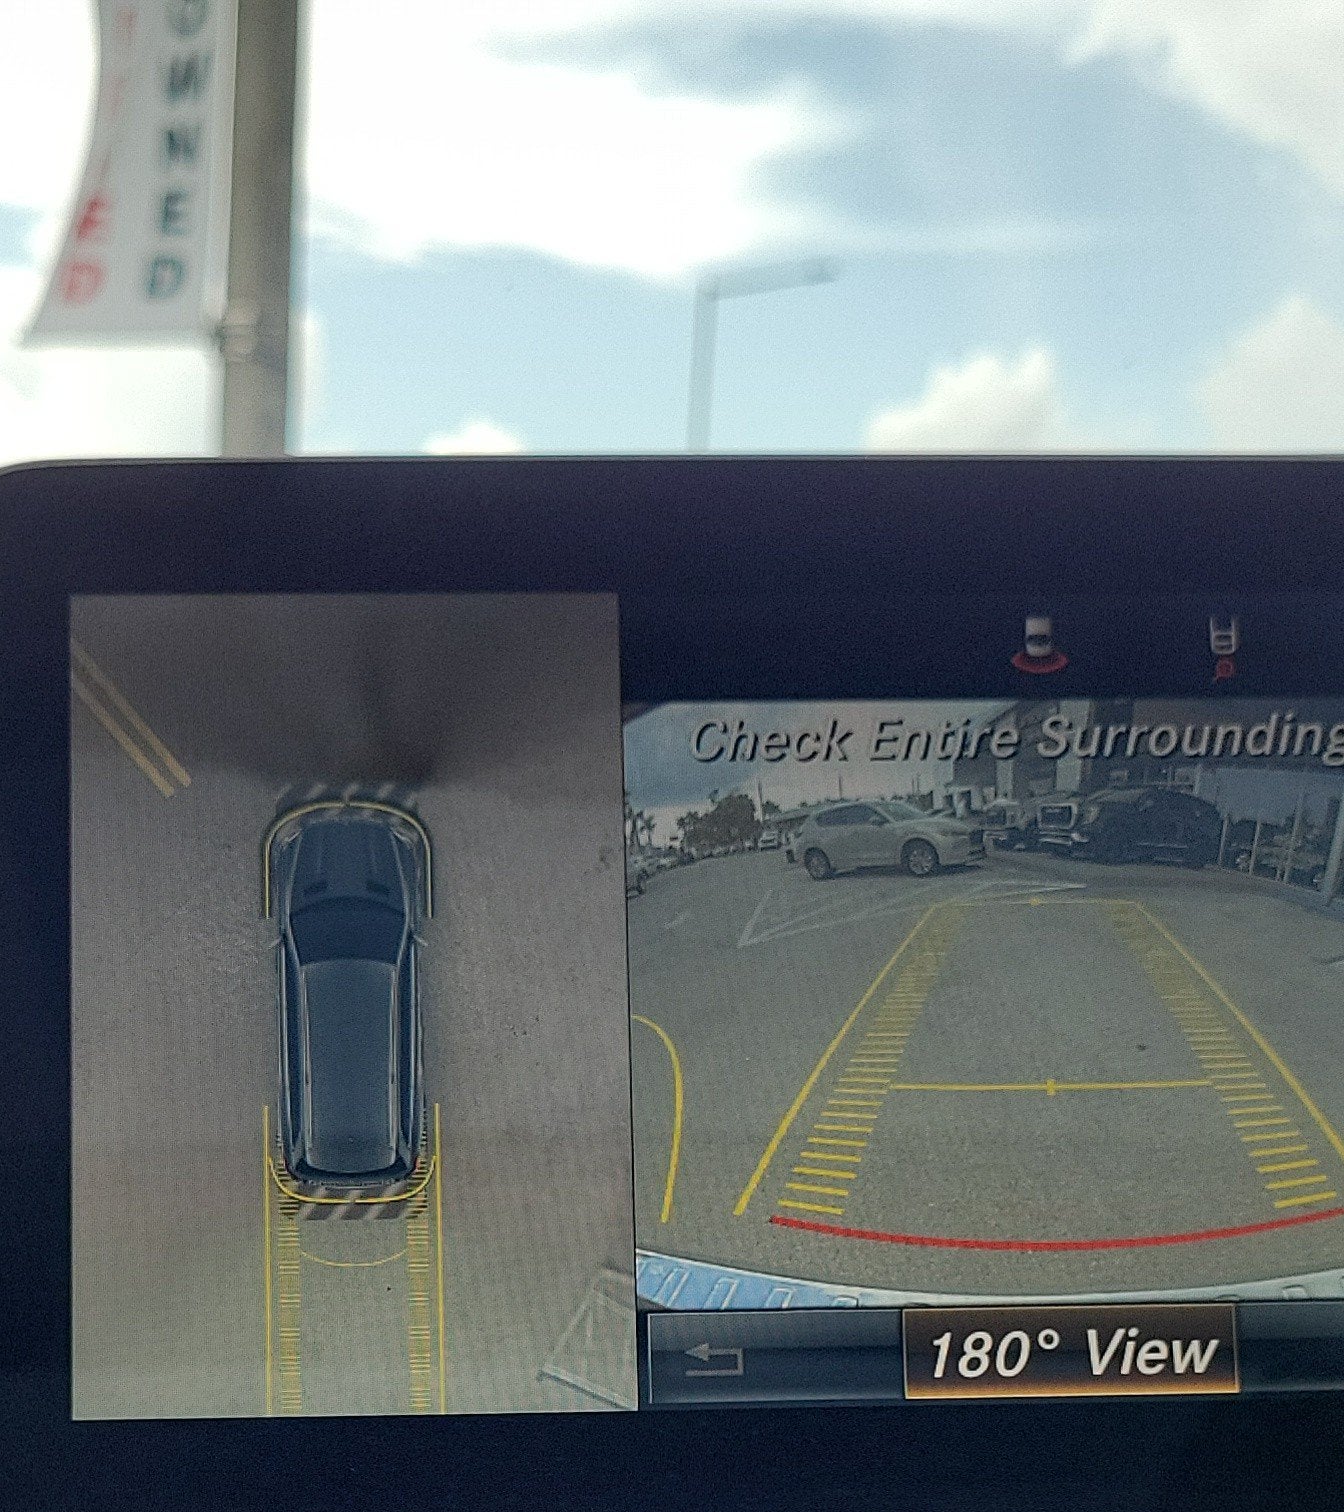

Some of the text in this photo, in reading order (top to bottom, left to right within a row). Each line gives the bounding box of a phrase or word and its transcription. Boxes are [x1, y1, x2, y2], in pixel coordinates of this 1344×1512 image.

[689, 717, 852, 764] Check
[869, 715, 1021, 762] Entire
[929, 1327, 1220, 1380] 180° View
